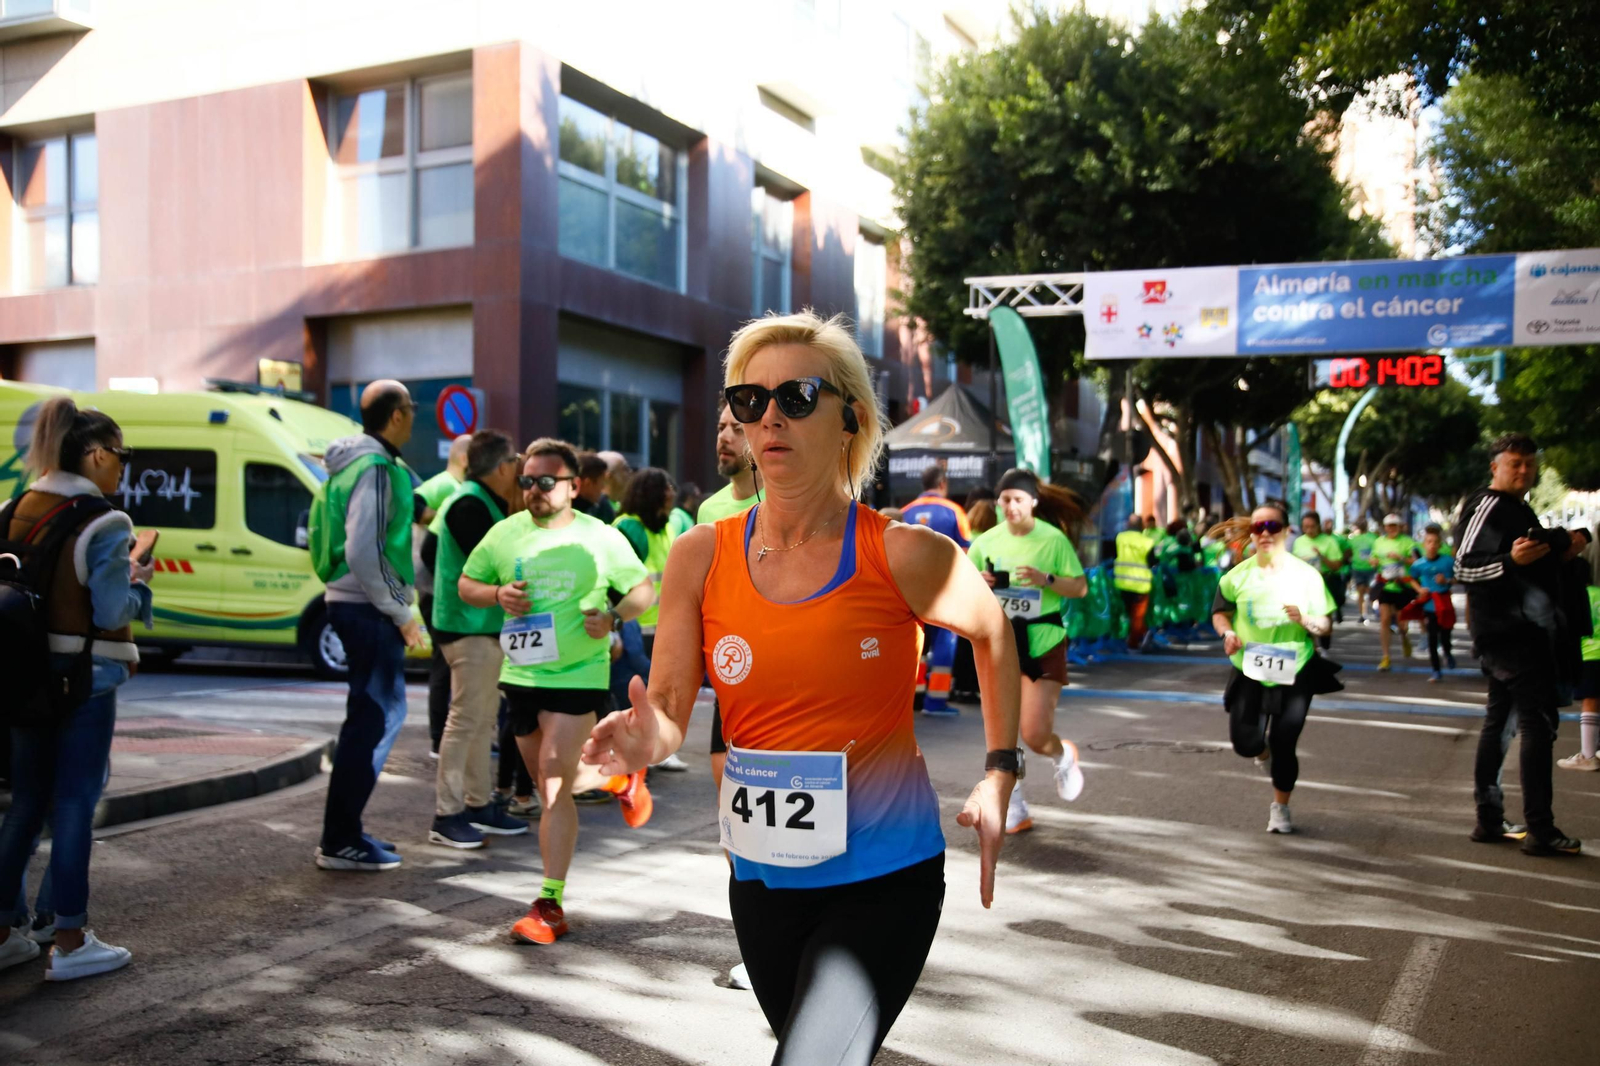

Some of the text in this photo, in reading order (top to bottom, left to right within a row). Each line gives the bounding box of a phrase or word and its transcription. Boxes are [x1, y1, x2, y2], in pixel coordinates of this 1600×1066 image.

[1254, 266, 1498, 295] Almería en marcha
[1252, 300, 1334, 322] contra
[1340, 297, 1365, 319] el
[1371, 295, 1463, 318] cáncer
[1001, 597, 1031, 612] 759
[509, 630, 543, 650] 272
[1254, 655, 1284, 671] 511
[735, 766, 744, 775] el
[745, 767, 778, 778] cáncer
[732, 787, 815, 830] 412
